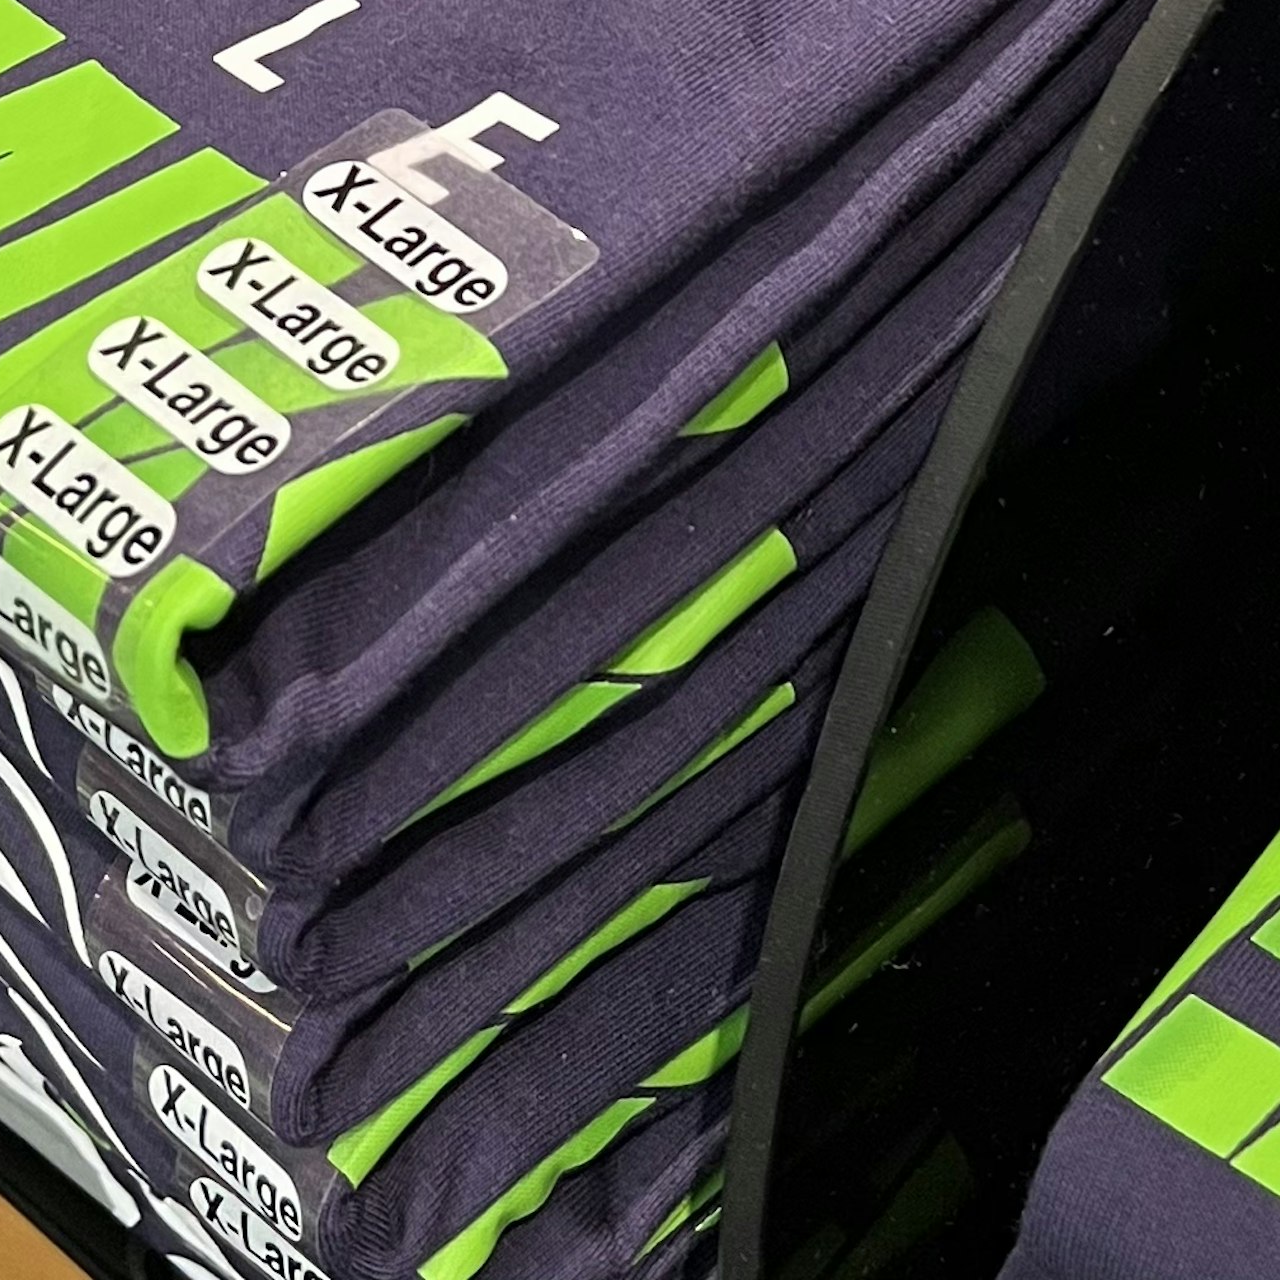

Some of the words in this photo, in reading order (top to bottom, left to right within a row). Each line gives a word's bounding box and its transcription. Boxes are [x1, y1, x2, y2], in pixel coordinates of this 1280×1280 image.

[312, 165, 498, 308] X-Large
[207, 241, 388, 385] X-Large
[96, 316, 280, 470] X-Large
[107, 956, 247, 1104] X-Large
[161, 1069, 301, 1236] X-Large
[199, 1182, 324, 1280] X-Lar
